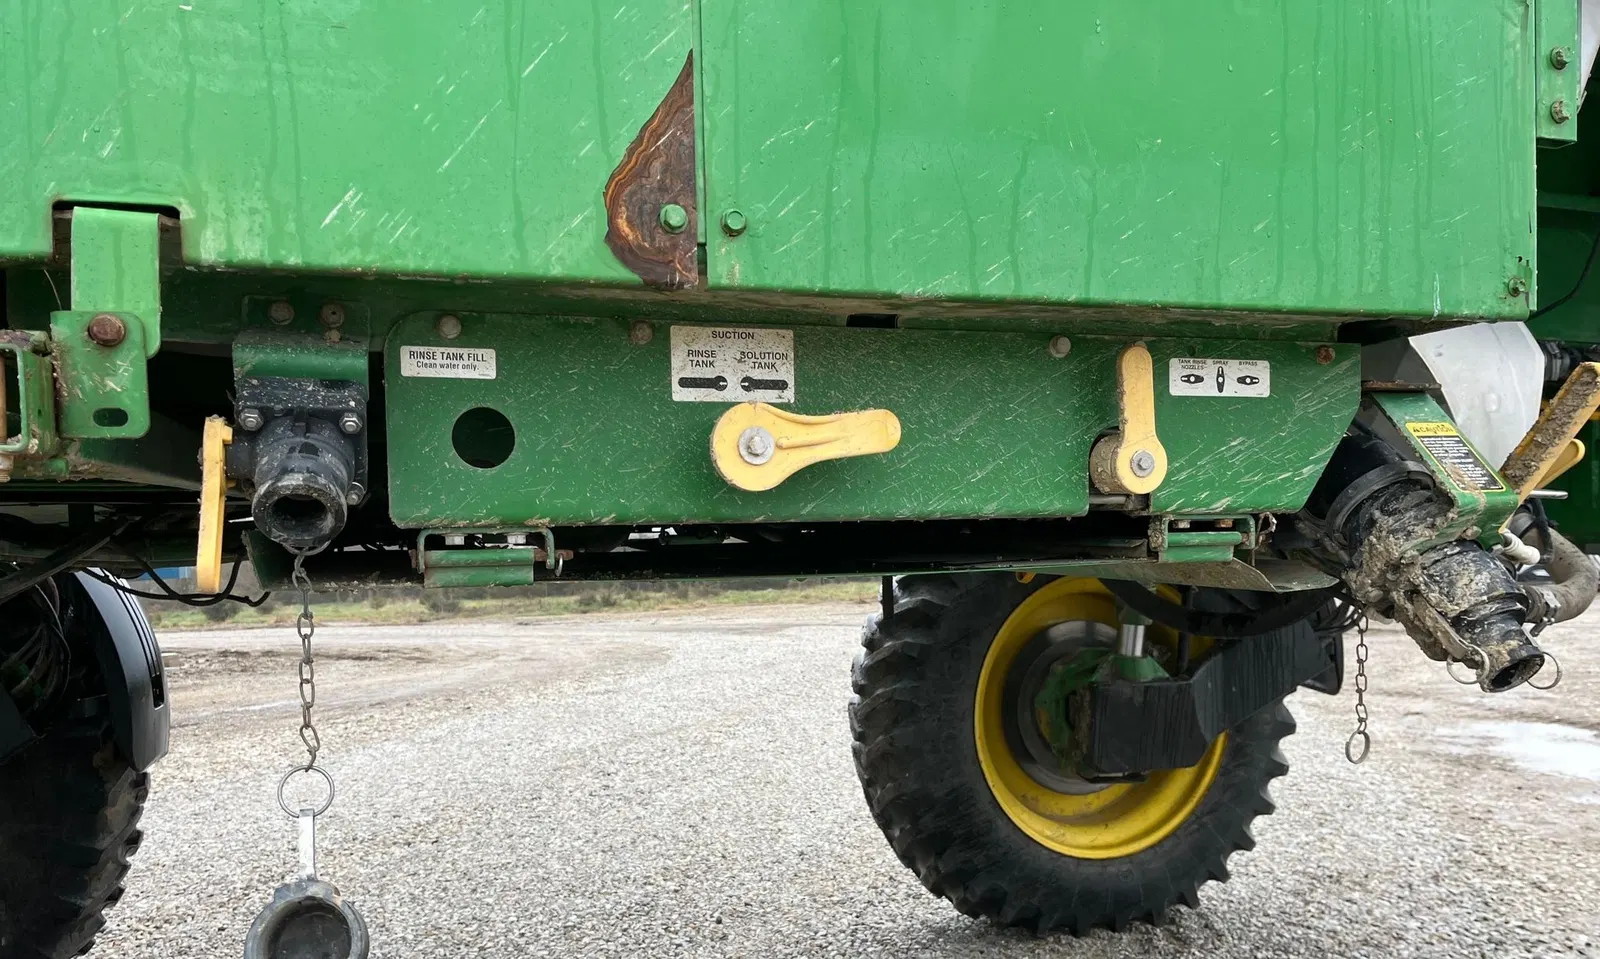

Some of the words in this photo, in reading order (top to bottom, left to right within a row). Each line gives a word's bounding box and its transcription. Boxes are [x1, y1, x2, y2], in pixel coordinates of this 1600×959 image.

[711, 330, 755, 340] SUCTION
[409, 351, 437, 360] RINSE
[440, 352, 465, 361] TANK
[467, 353, 487, 362] FILL
[687, 349, 717, 359] RINSE
[739, 351, 788, 360] SOLUTION
[416, 360, 437, 369] Clean
[439, 362, 460, 370] water
[461, 362, 479, 371] only.
[689, 359, 716, 368] TANK
[751, 361, 777, 370] TANK
